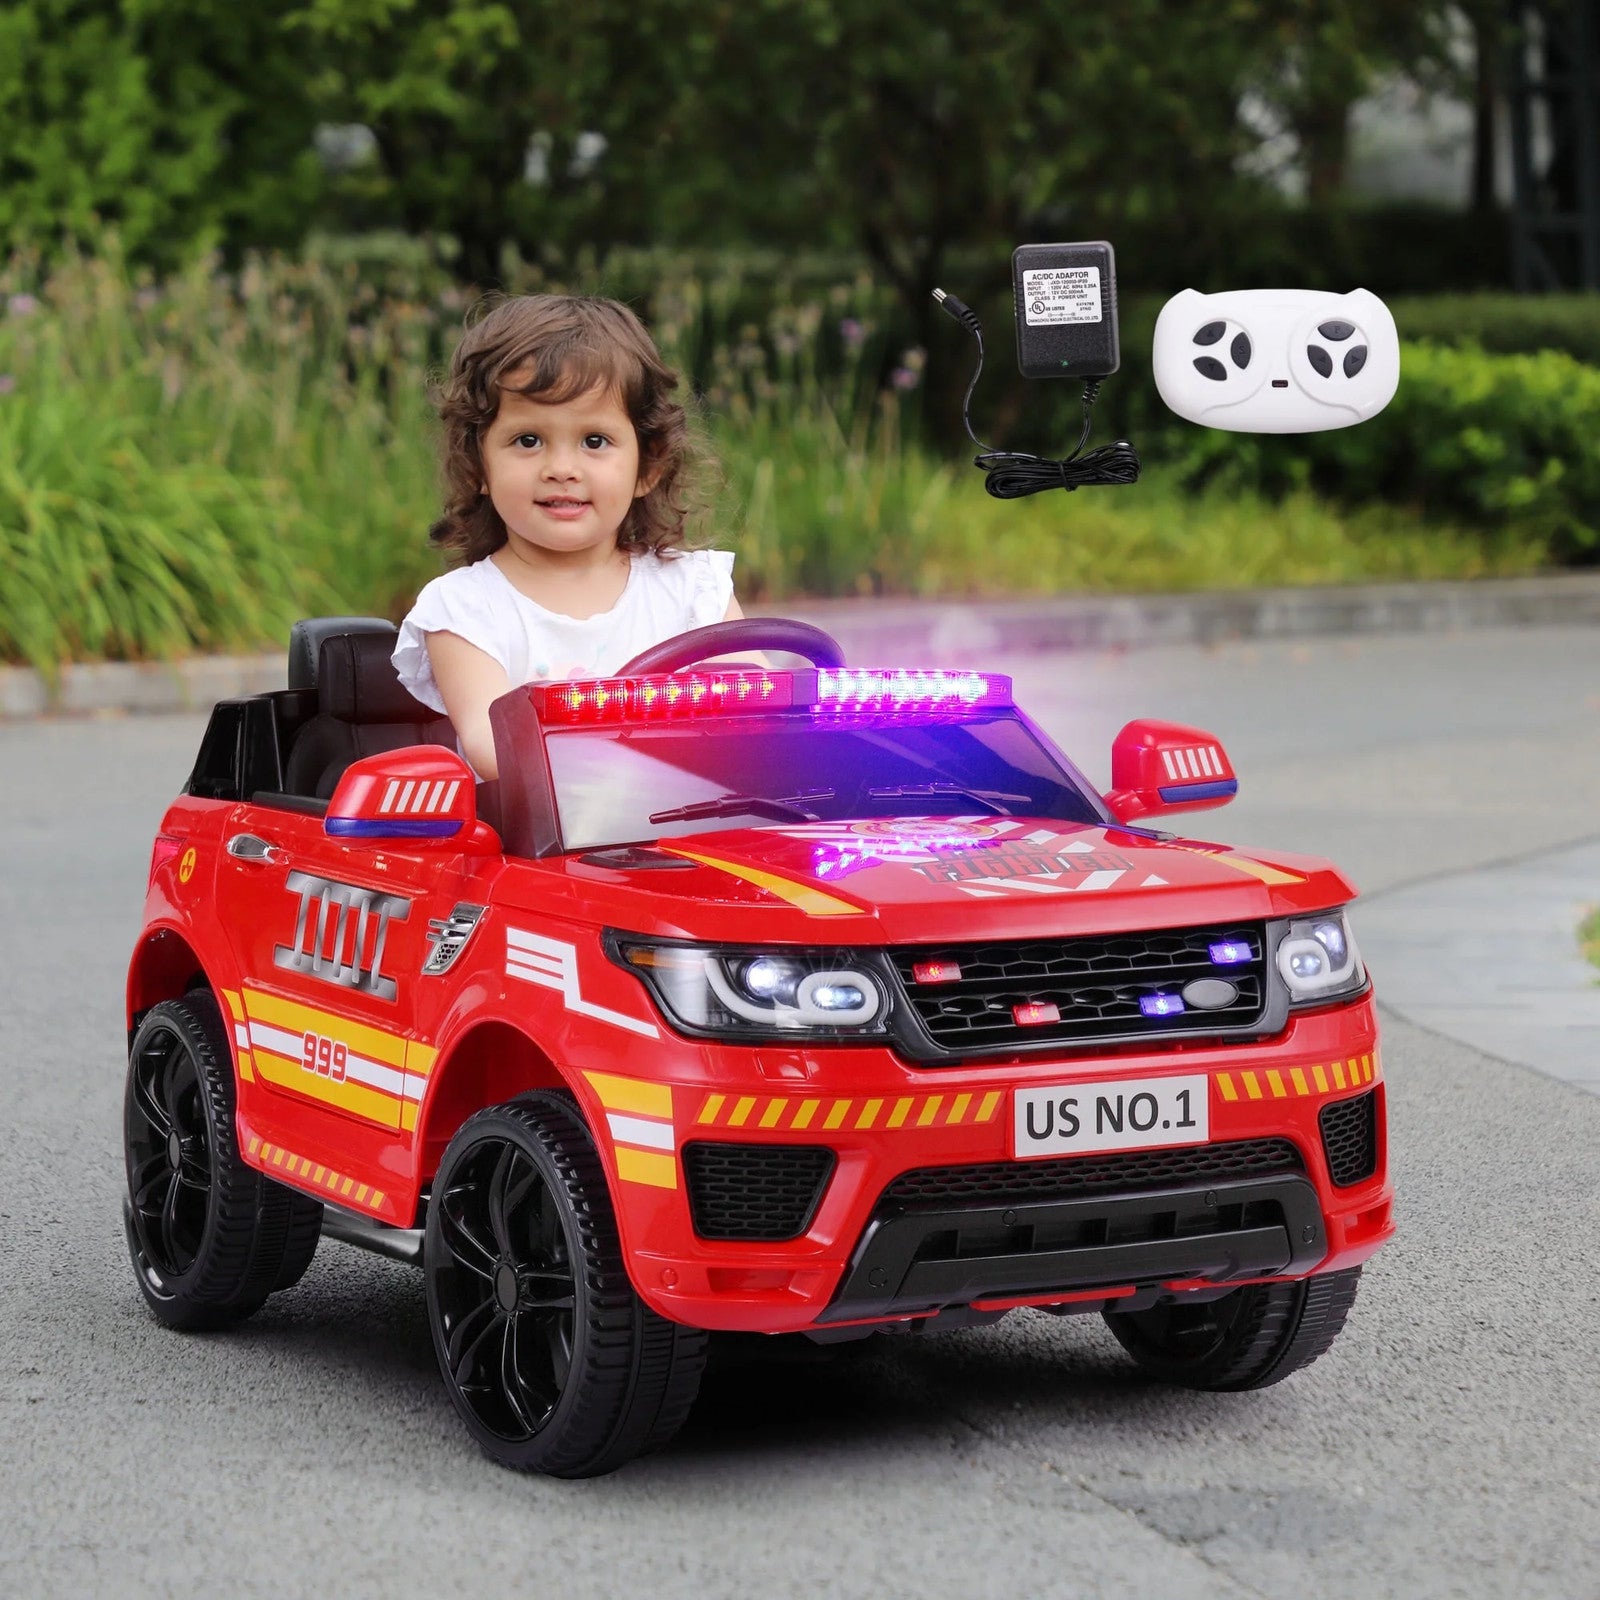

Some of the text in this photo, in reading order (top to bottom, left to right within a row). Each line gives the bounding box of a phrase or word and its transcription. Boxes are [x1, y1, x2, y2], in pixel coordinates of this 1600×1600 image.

[1055, 271, 1089, 279] ADAPTOR
[912, 852, 1134, 883] FIGHTER
[302, 1031, 348, 1084] 999
[1026, 1089, 1196, 1140] US NO.1
